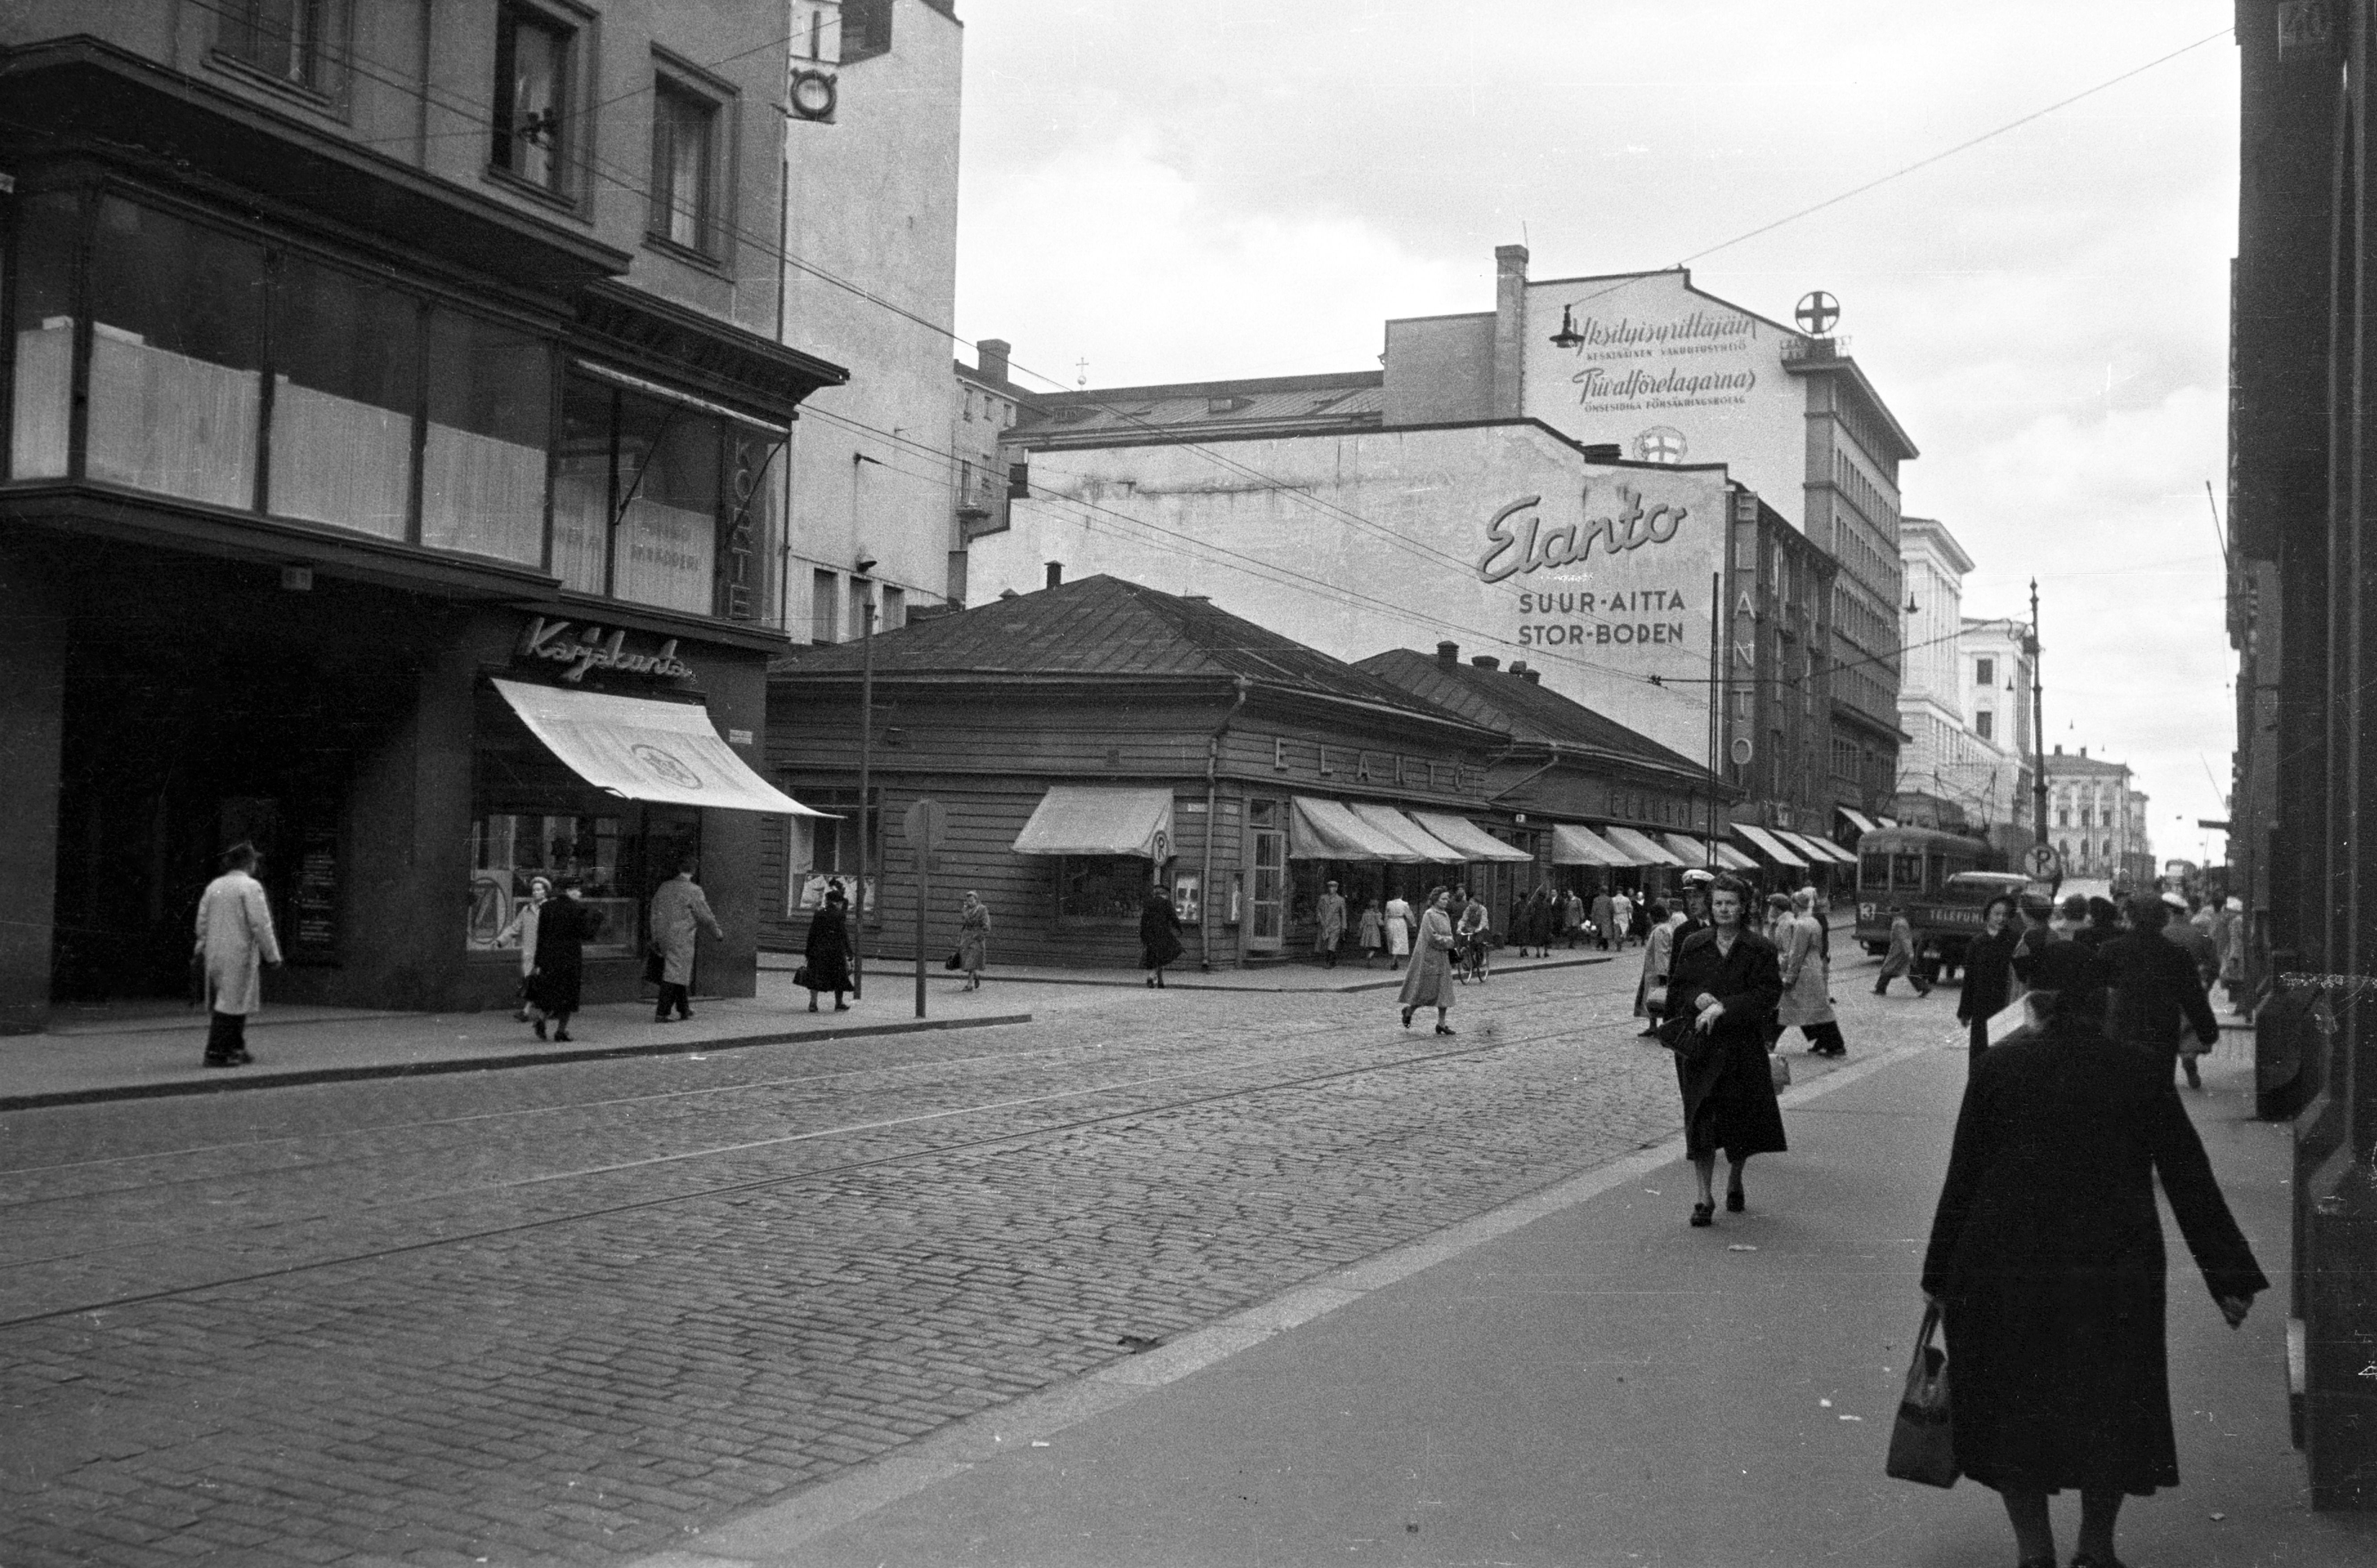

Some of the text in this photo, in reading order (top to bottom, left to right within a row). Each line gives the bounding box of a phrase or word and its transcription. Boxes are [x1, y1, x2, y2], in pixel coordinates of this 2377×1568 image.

[1476, 493, 1687, 584] Elanto
[1519, 589, 1685, 614] SUUR-AITTA
[1731, 492, 1757, 764] ELANTO
[523, 617, 697, 682] Karjakunta
[1518, 623, 1683, 645] STOR-BODEN
[1275, 737, 1465, 792] ELANTO
[2036, 850, 2051, 873] P
